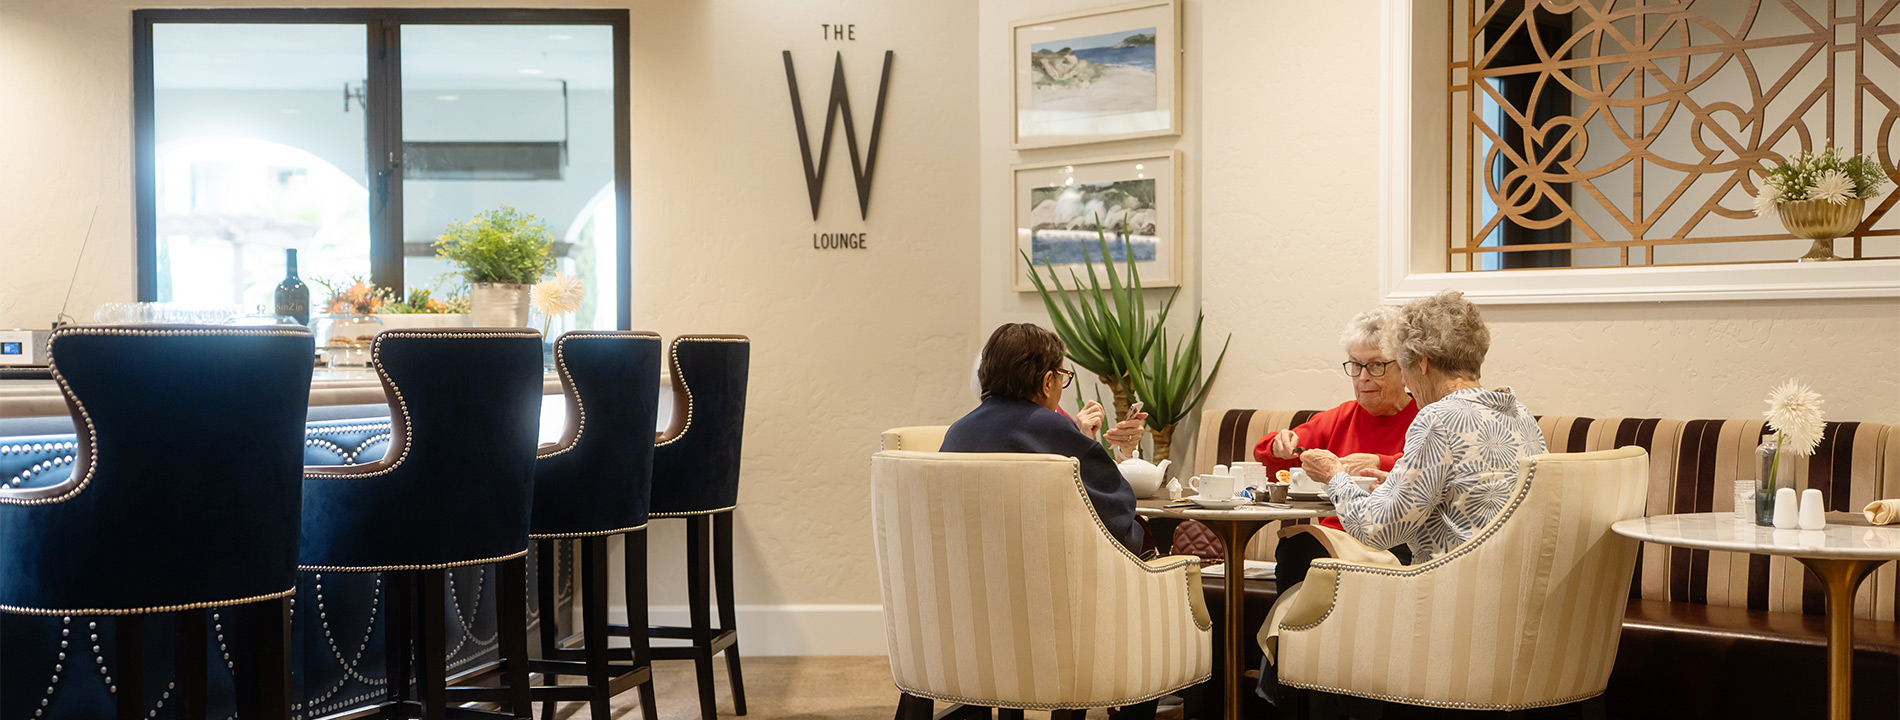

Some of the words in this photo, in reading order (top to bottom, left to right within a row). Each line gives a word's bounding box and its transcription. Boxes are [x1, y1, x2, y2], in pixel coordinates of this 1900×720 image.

[821, 24, 856, 41] THE
[782, 50, 894, 222] W
[813, 233, 867, 250] LOUNGE
